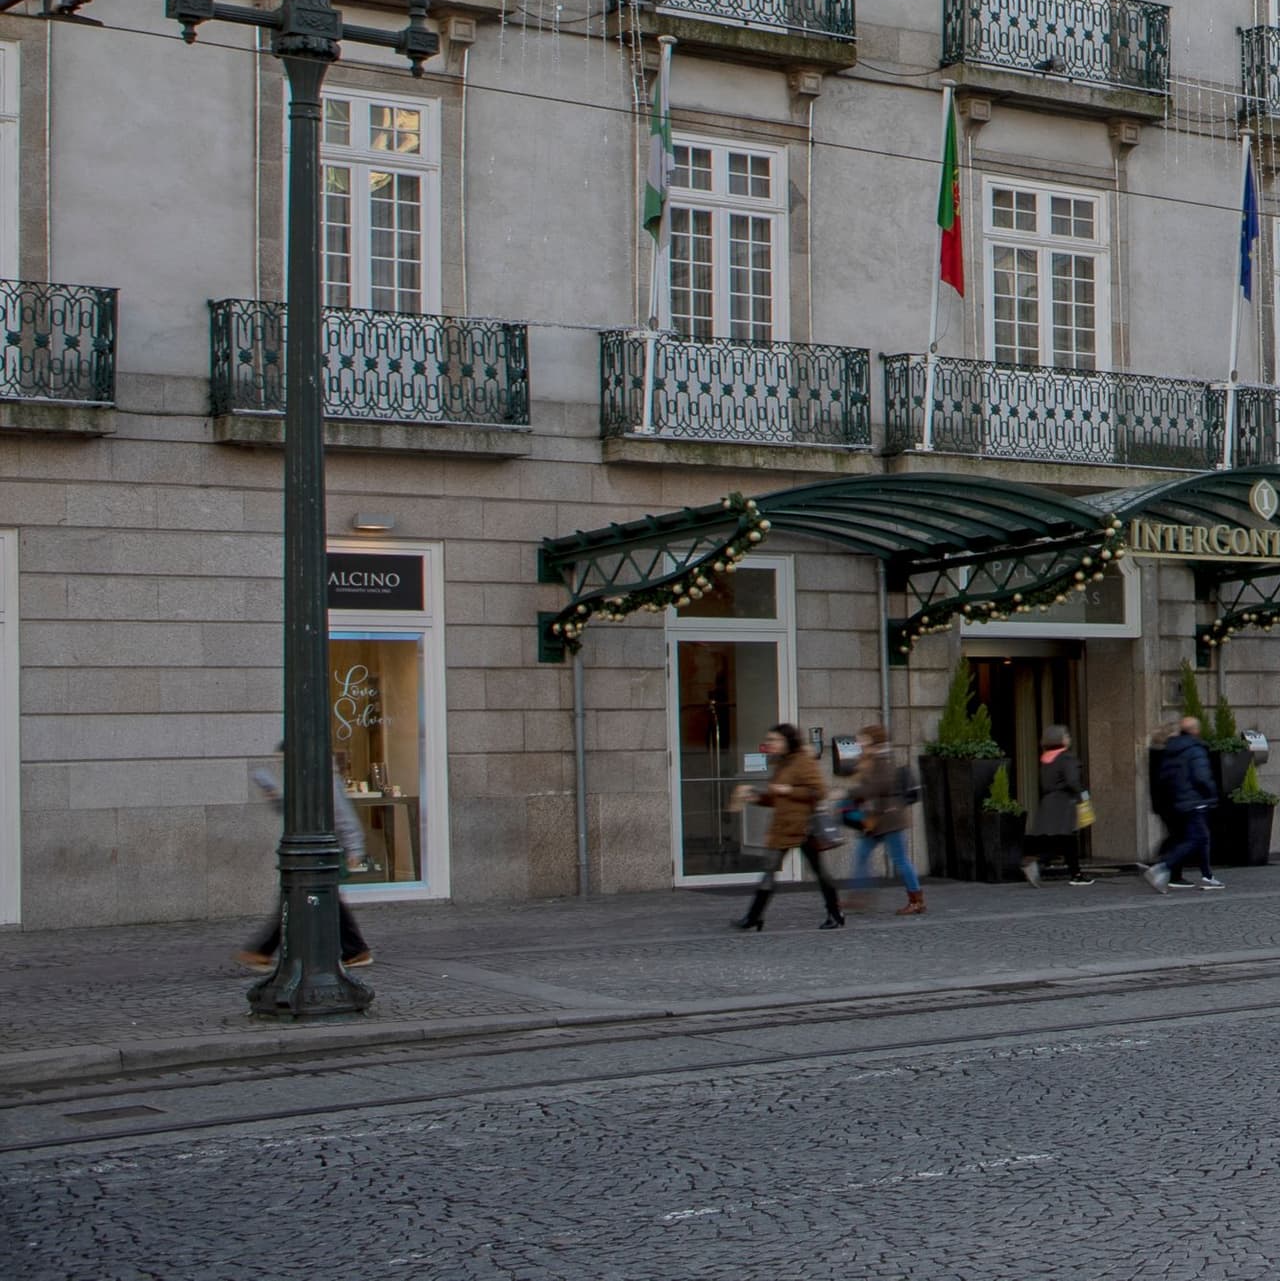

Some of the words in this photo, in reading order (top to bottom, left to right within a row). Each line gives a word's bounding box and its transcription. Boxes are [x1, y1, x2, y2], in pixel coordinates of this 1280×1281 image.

[327, 571, 401, 588] ALCINO
[335, 664, 378, 699] Love
[334, 697, 394, 740] Silver
